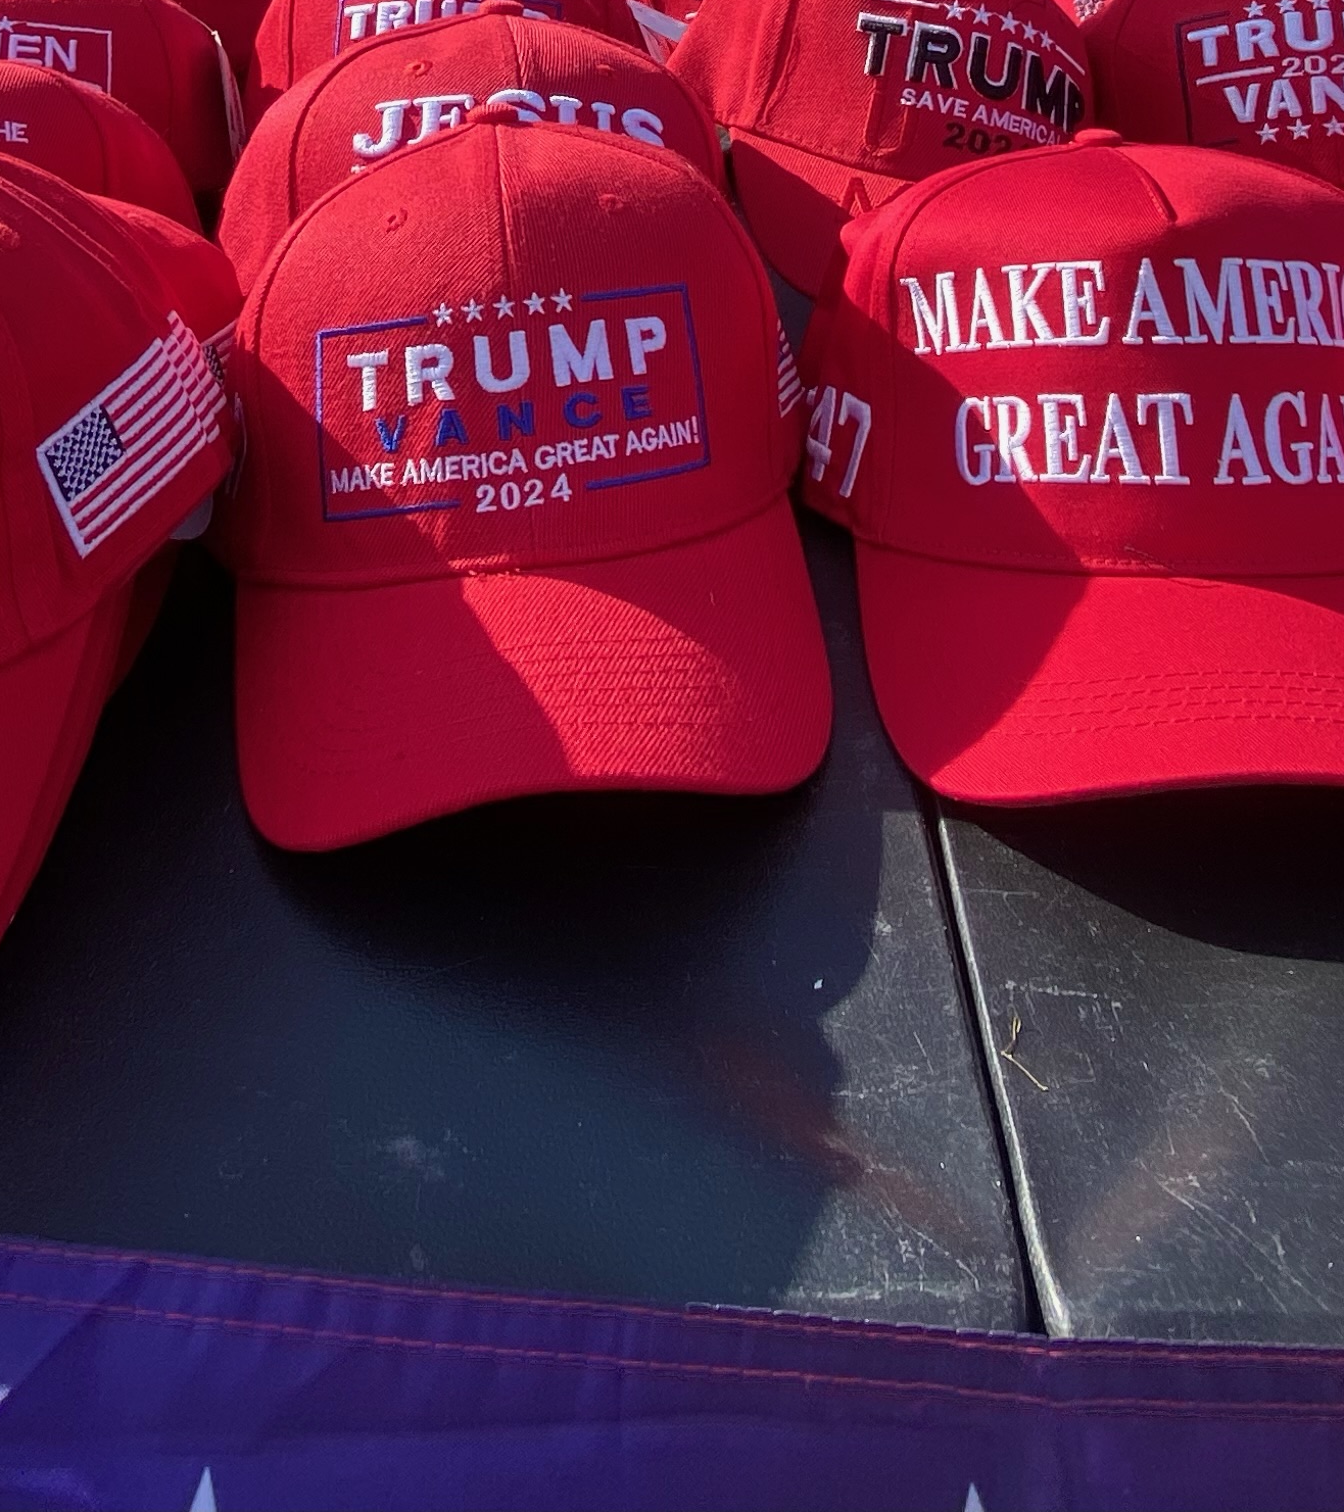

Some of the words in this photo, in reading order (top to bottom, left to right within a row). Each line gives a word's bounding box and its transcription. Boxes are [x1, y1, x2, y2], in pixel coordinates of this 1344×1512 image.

[856, 11, 1086, 134] TRUMP
[899, 88, 970, 118] SAVE
[942, 121, 1030, 156] 202
[899, 259, 1111, 356] MAKE
[346, 315, 668, 411] TRUMP
[330, 458, 394, 496] MAKE
[401, 449, 527, 486] AMERICA
[534, 434, 618, 470] GREAT
[625, 415, 700, 453] AGAIN!
[373, 385, 653, 454] VANCE
[957, 392, 1193, 487] GREAT
[475, 474, 573, 514] 2024
